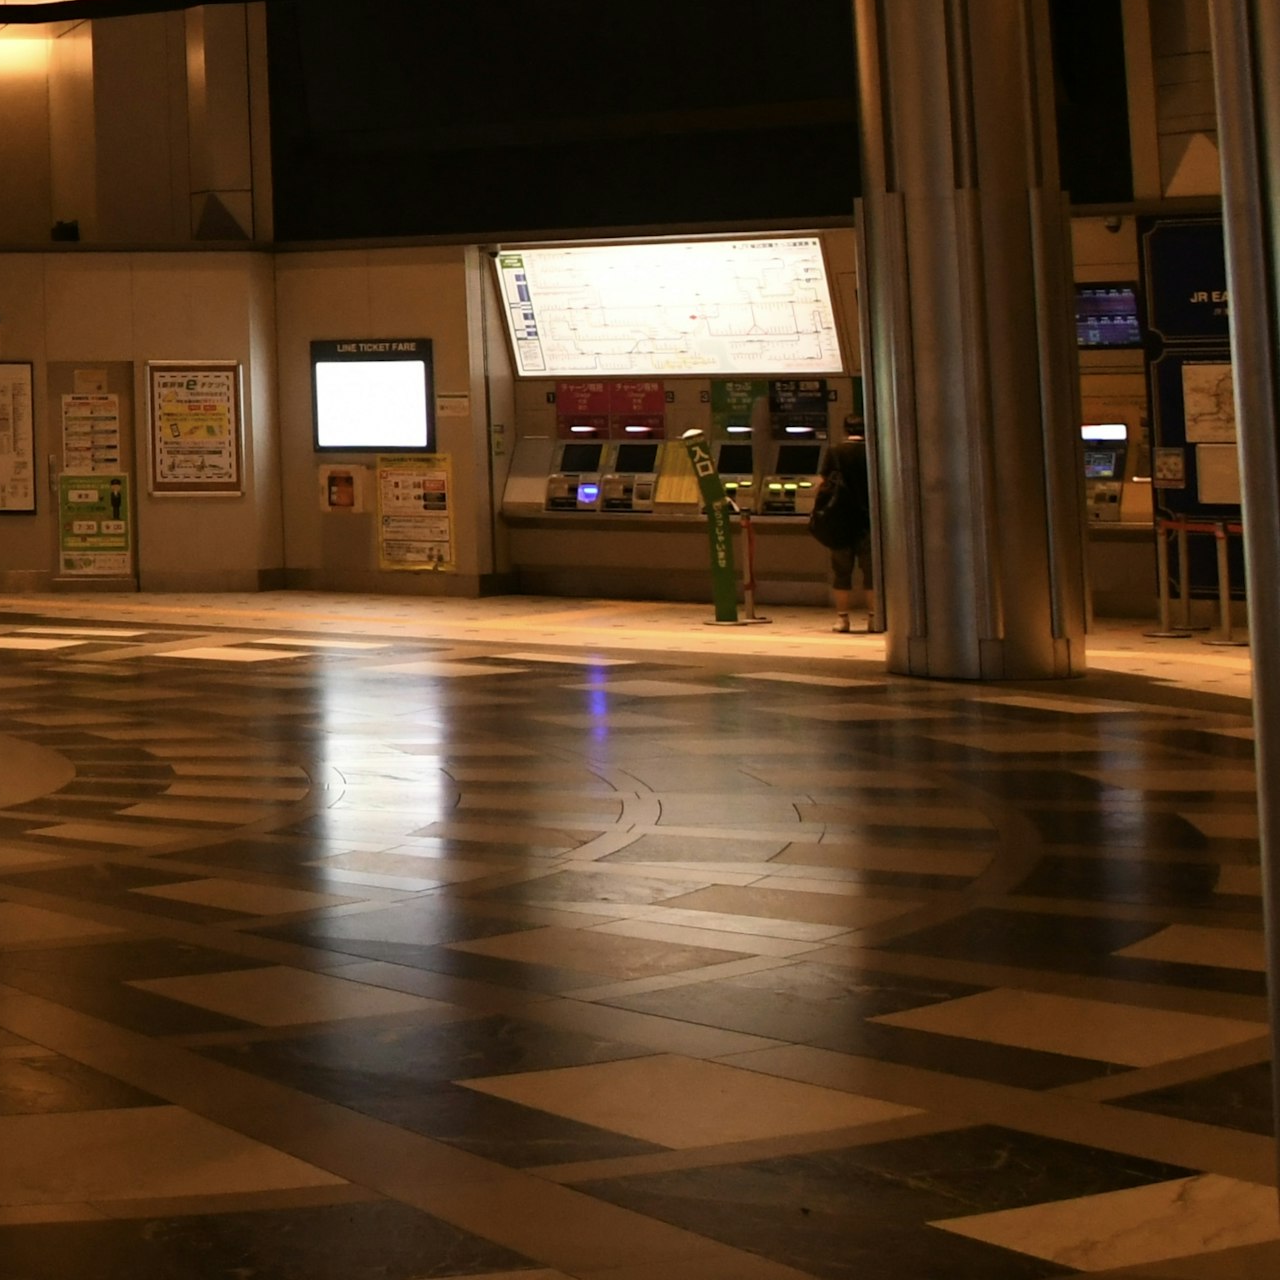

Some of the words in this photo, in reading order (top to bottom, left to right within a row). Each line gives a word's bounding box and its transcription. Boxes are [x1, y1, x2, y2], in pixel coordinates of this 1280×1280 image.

[1189, 291, 1208, 303] JR
[337, 343, 357, 353] LINE
[359, 342, 390, 352] TICKET
[392, 342, 417, 351] FARE
[691, 445, 715, 478] 入口
